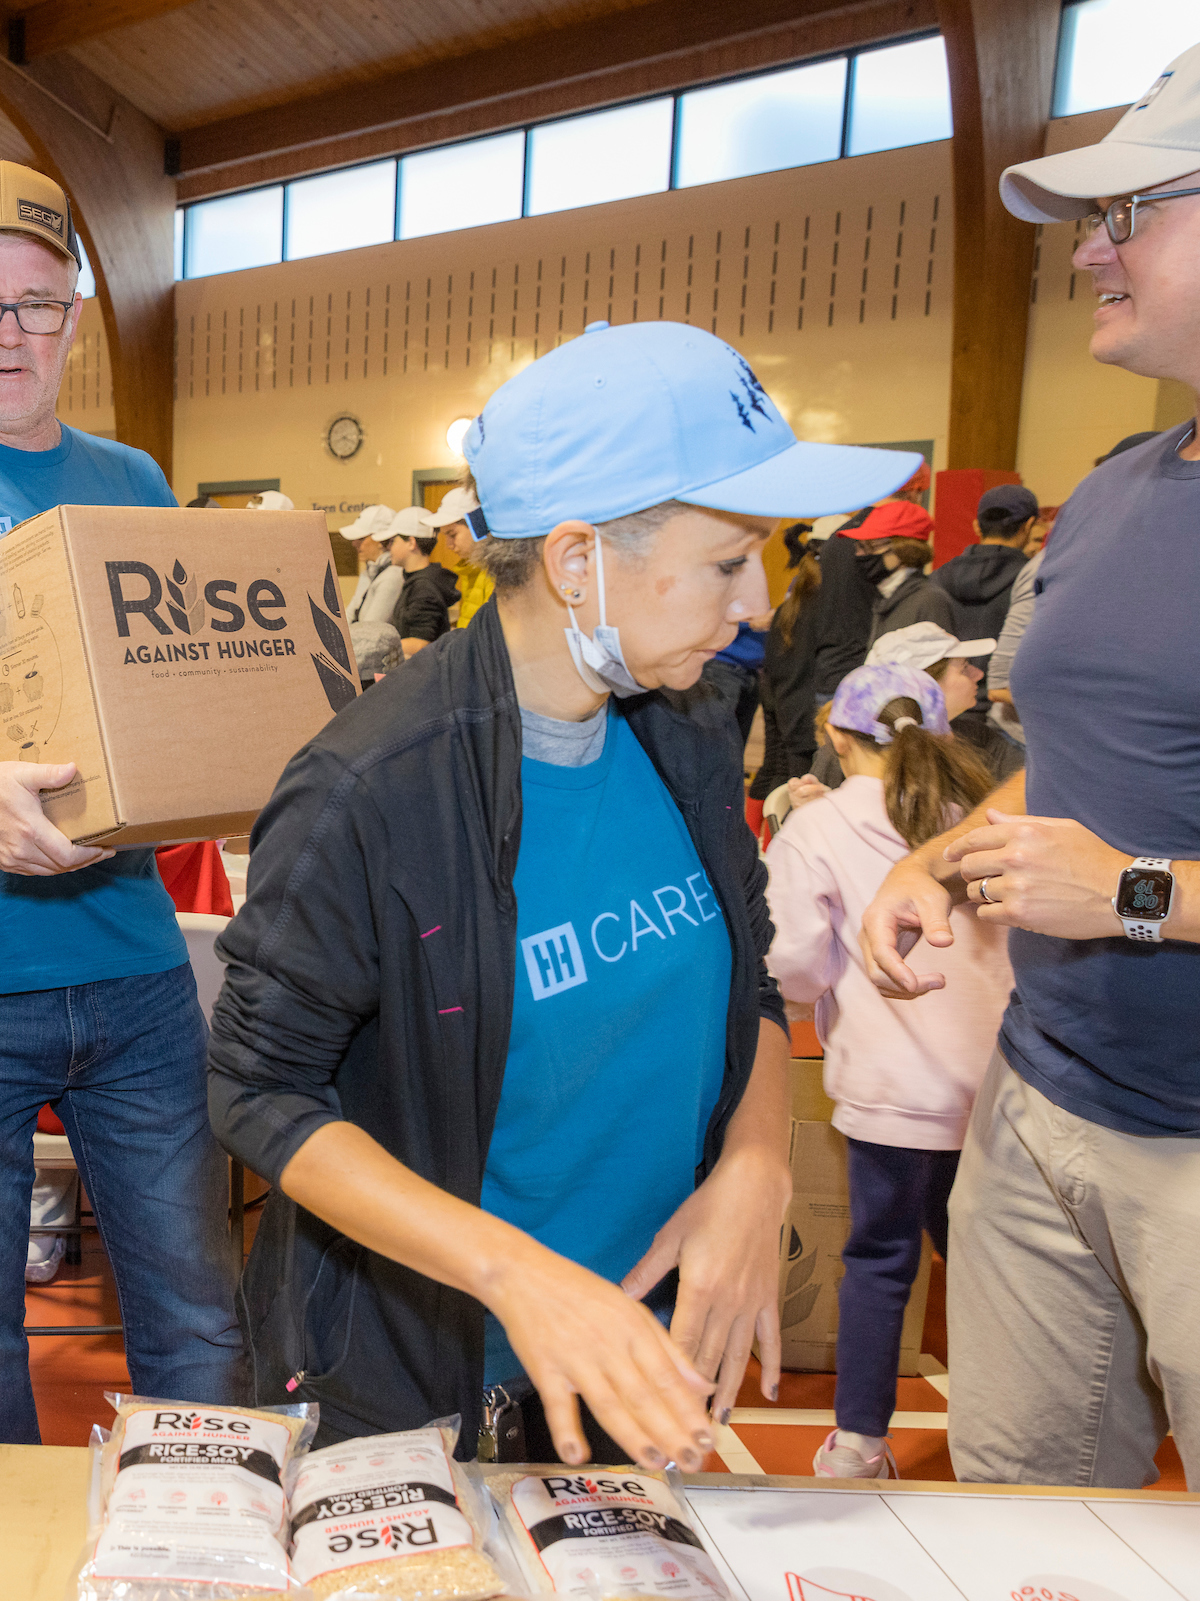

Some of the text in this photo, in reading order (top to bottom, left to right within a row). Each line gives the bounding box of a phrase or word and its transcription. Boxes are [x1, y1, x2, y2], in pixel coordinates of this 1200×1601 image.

[104, 558, 288, 638] Rise
[123, 638, 297, 665] AGAINST HUNGER
[151, 664, 279, 679] food community sustainability
[153, 1412, 251, 1434] Rise
[202, 1431, 250, 1441] HUNGER
[149, 1443, 255, 1461] RICE-SOY
[159, 1456, 239, 1465] FORTIFIED MEAL
[356, 1483, 409, 1500] FORTIFIED
[541, 1475, 647, 1499] Rise
[316, 1487, 426, 1520] RICE-SOY
[327, 1491, 357, 1504] MEAL
[555, 1494, 654, 1508] AGAINST HUNGER
[325, 1508, 430, 1534] AGAINST HUNGER
[563, 1508, 667, 1531] RICE-SOY
[328, 1516, 439, 1553] Rise
[583, 1523, 634, 1537] FORTIFIED
